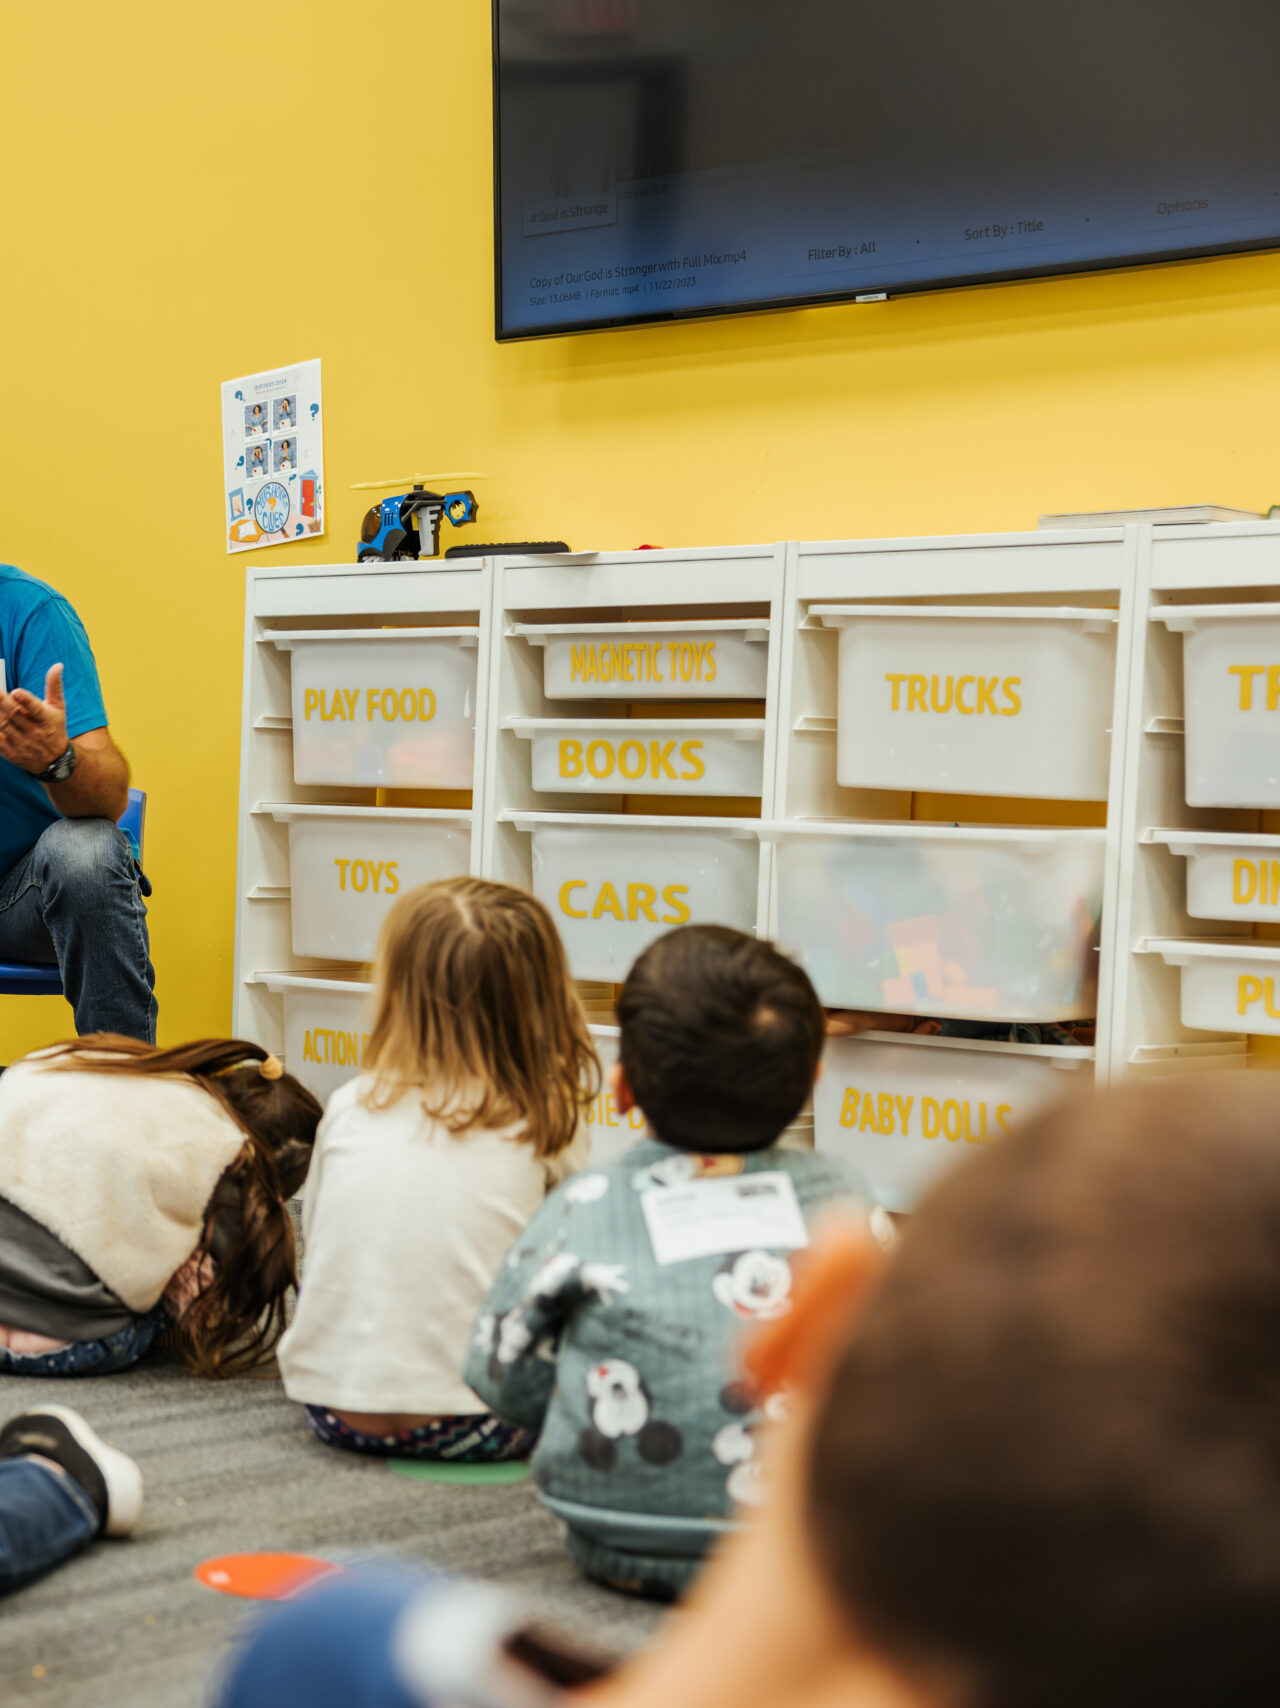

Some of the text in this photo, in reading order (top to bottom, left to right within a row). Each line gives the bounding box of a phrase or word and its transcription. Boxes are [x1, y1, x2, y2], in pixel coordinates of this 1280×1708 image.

[538, 207, 559, 223] God
[560, 207, 569, 219] is
[964, 225, 990, 241] Sort
[992, 223, 1008, 239] By
[1016, 218, 1045, 234] Title
[529, 249, 747, 290] Copy of Our God is Stronger with Full Mix.mp4
[807, 247, 837, 261] Filter
[838, 244, 852, 259] By
[859, 240, 877, 254] All
[621, 283, 640, 296] mp4
[648, 276, 697, 293] 11/22/2023
[570, 641, 716, 683] MAGNETIC TOYS
[304, 688, 436, 722] PLAY FOOD
[885, 673, 1022, 716] TRUCKS
[558, 739, 705, 781] BOOKS
[333, 858, 400, 895] TOYS
[558, 879, 692, 925] CARS
[302, 1028, 358, 1067] ACTION
[839, 1087, 914, 1137] BABY
